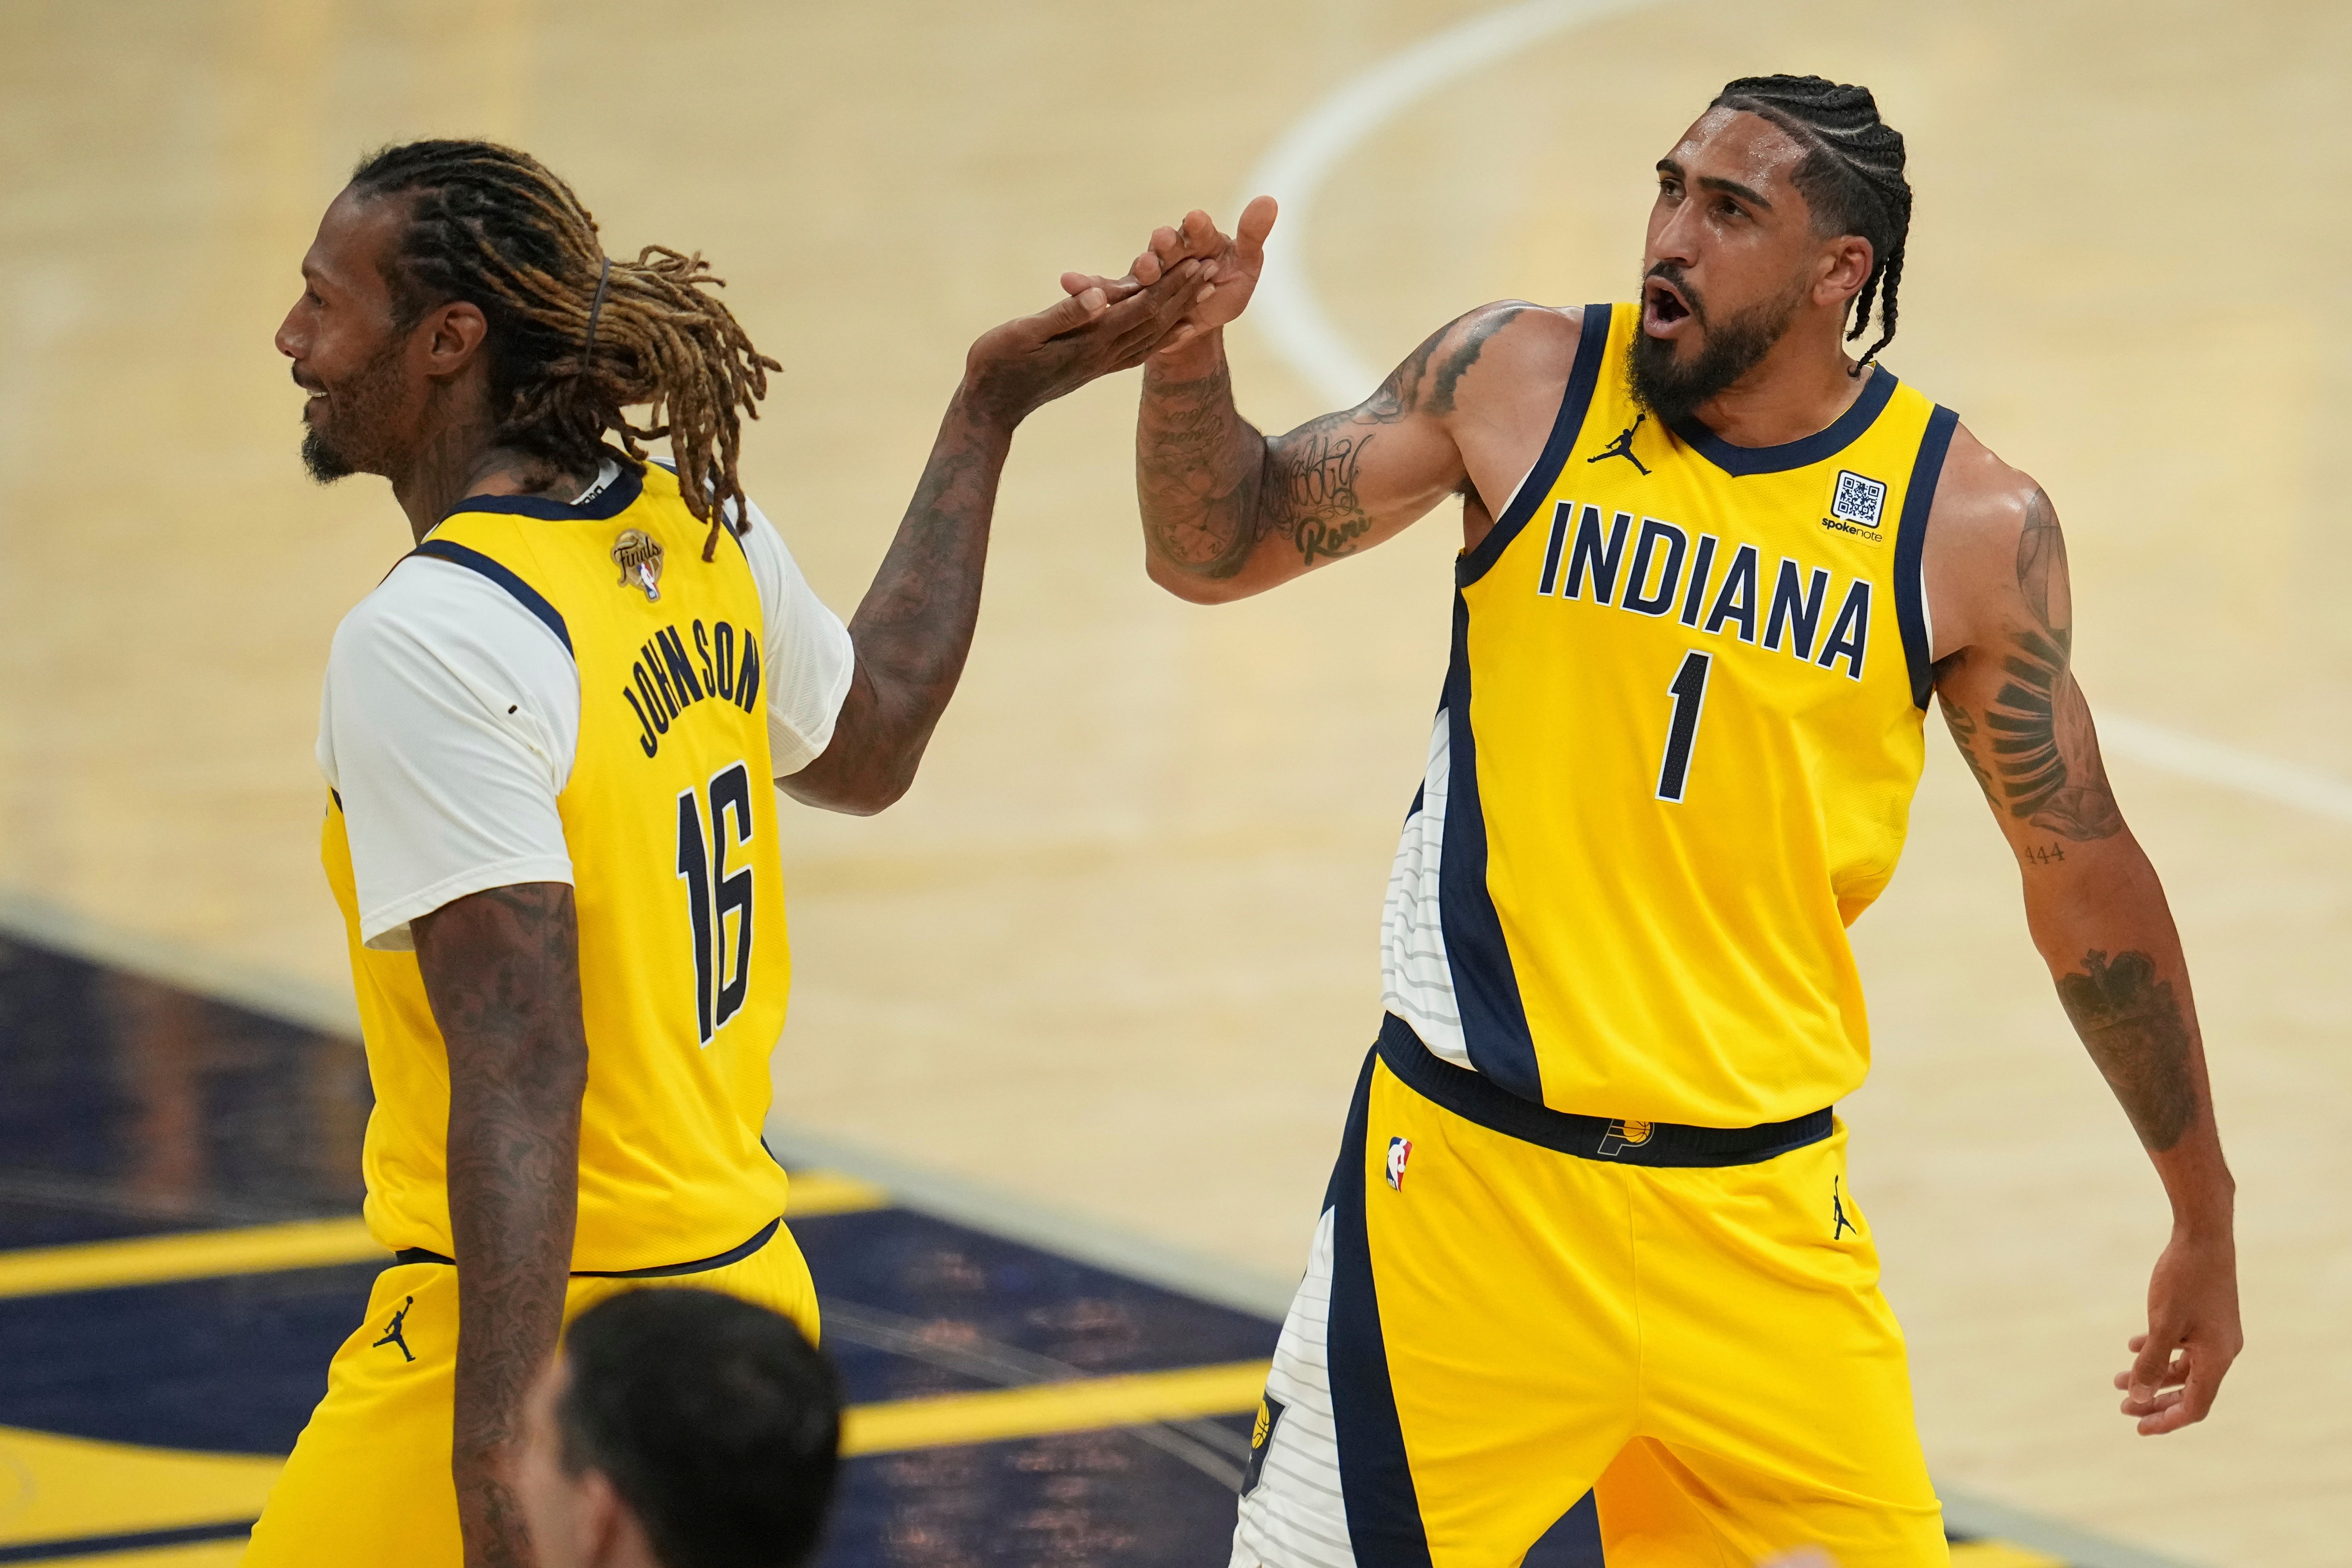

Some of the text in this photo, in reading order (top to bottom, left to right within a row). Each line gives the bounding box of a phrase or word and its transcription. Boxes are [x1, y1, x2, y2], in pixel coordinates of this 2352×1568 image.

[614, 536, 661, 583] Finals
[1537, 499, 1873, 683] INDIANA
[1822, 518, 1883, 542] spokenote
[623, 619, 760, 758] JOHNSON
[1654, 648, 1713, 804] 1
[675, 759, 753, 1050] 16
[2025, 842, 2065, 865] 444
